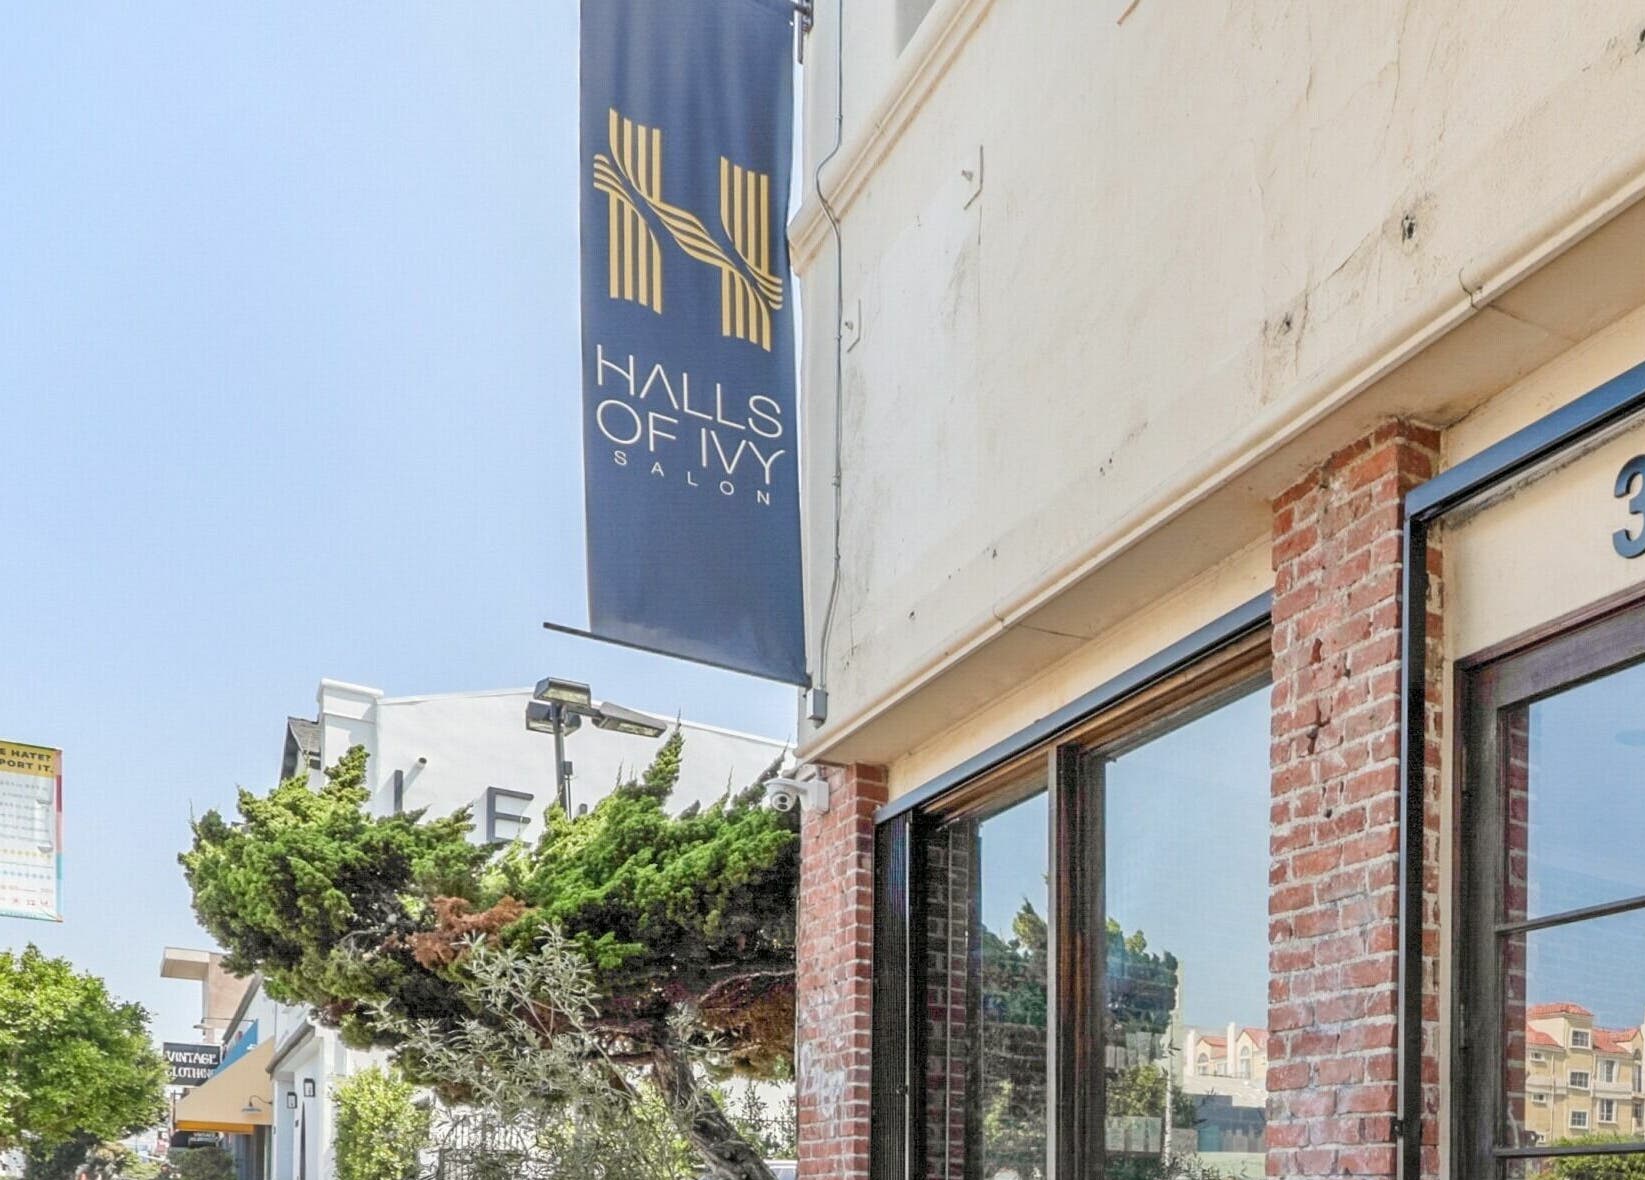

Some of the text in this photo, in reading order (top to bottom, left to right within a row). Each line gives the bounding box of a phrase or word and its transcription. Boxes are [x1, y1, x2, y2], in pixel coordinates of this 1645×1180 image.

[597, 344, 783, 438] HALLS
[597, 400, 786, 485] OF IVY
[613, 450, 770, 505] SALON
[11, 749, 52, 762] HATE?
[0, 758, 33, 769] PORT
[166, 1050, 218, 1065] VINTAGE
[165, 1065, 212, 1079] CLOTHIN
